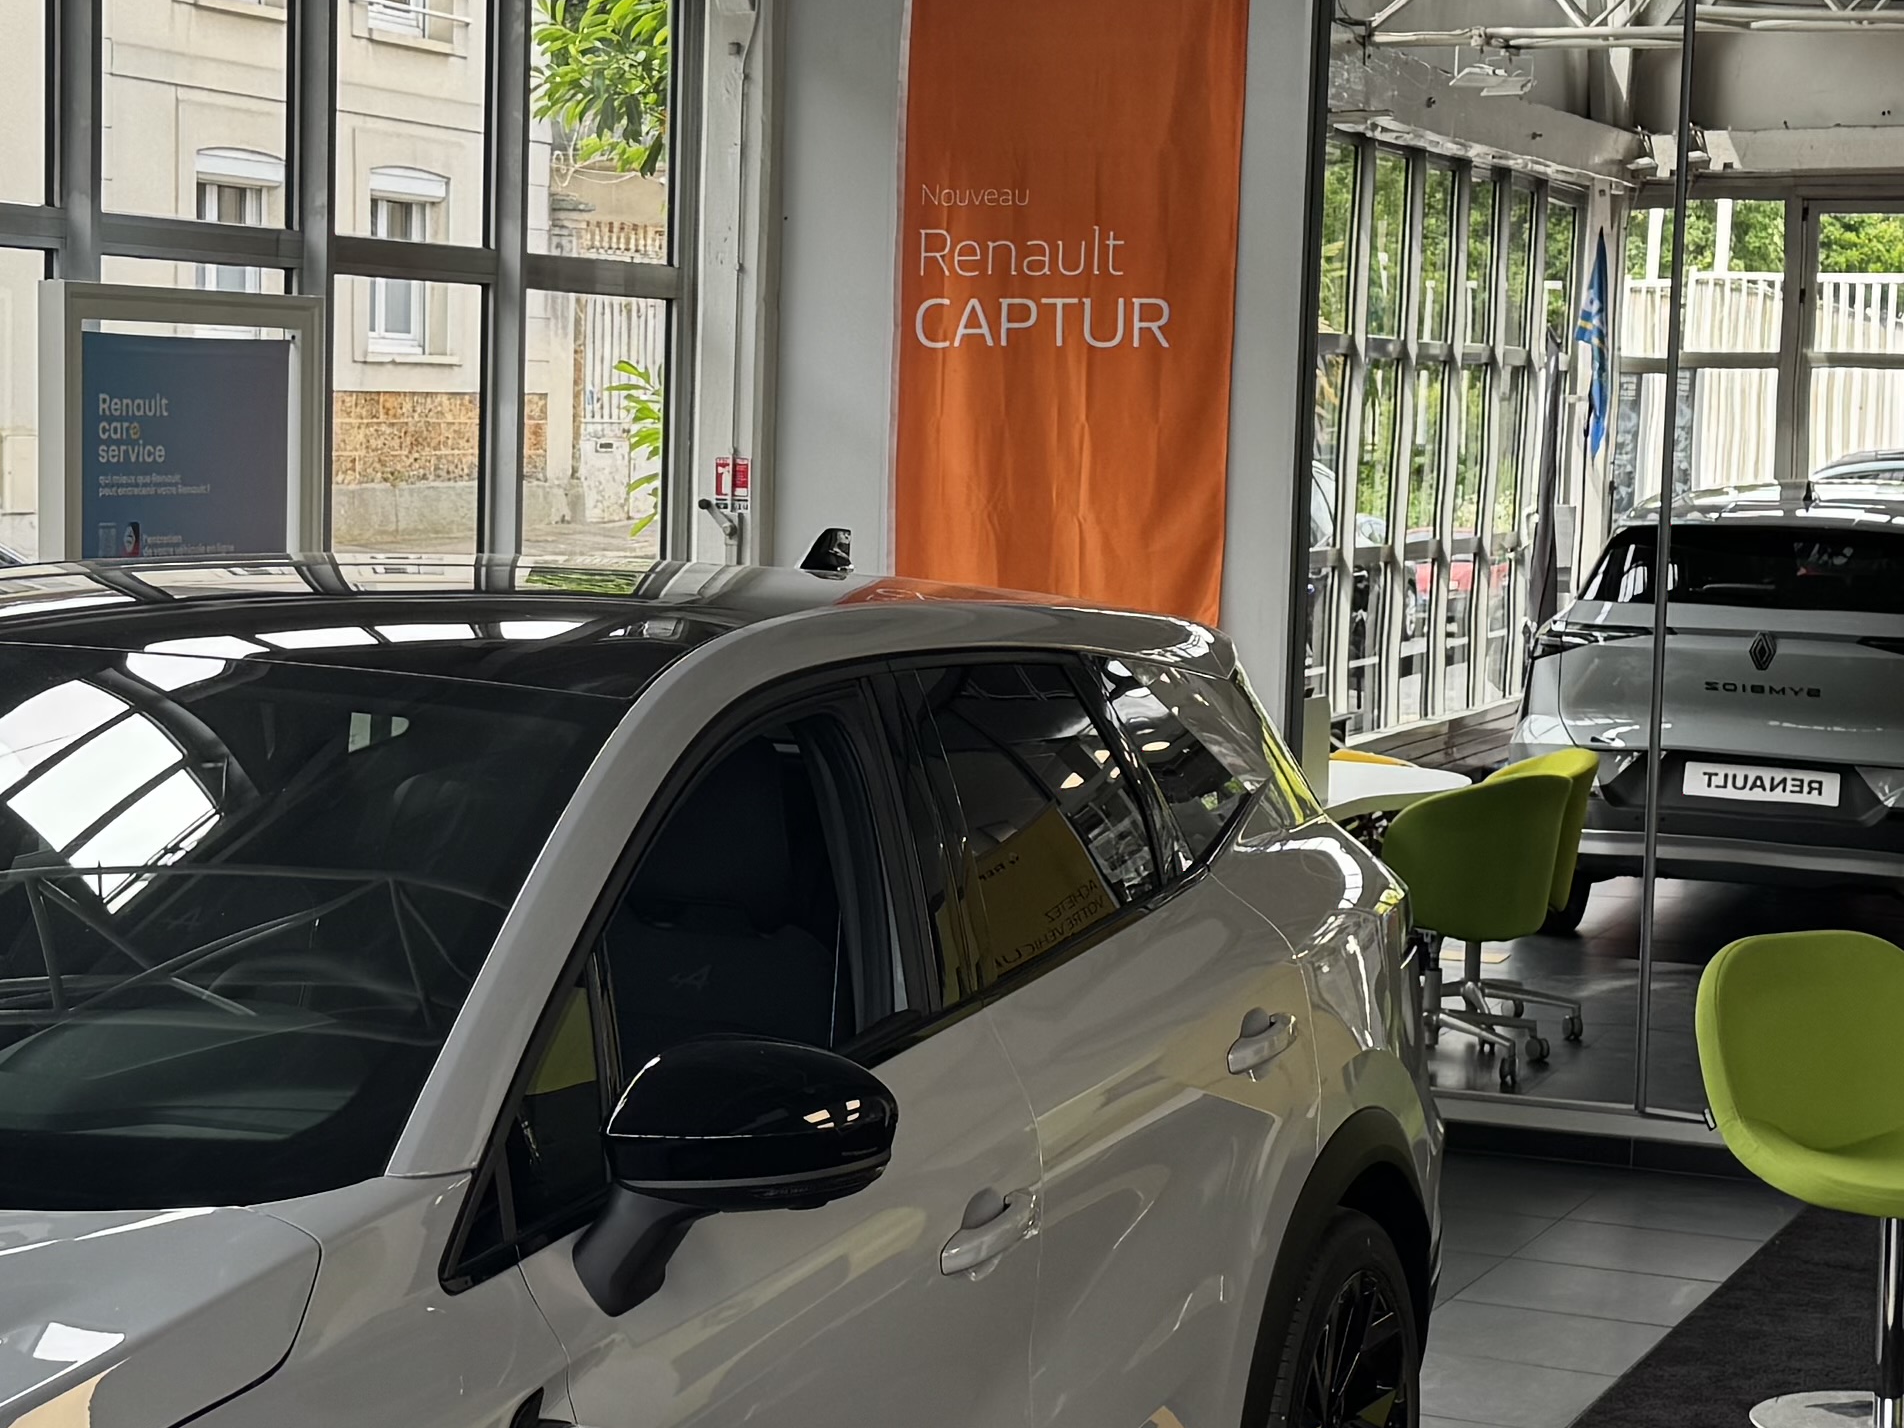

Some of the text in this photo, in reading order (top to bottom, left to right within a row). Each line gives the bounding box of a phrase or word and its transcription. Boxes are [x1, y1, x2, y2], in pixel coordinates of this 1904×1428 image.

[921, 183, 1030, 208] Nouveau
[919, 225, 1125, 277] Renault
[914, 297, 1171, 349] CAPTUR
[99, 393, 169, 416] Renault
[98, 440, 165, 463] service
